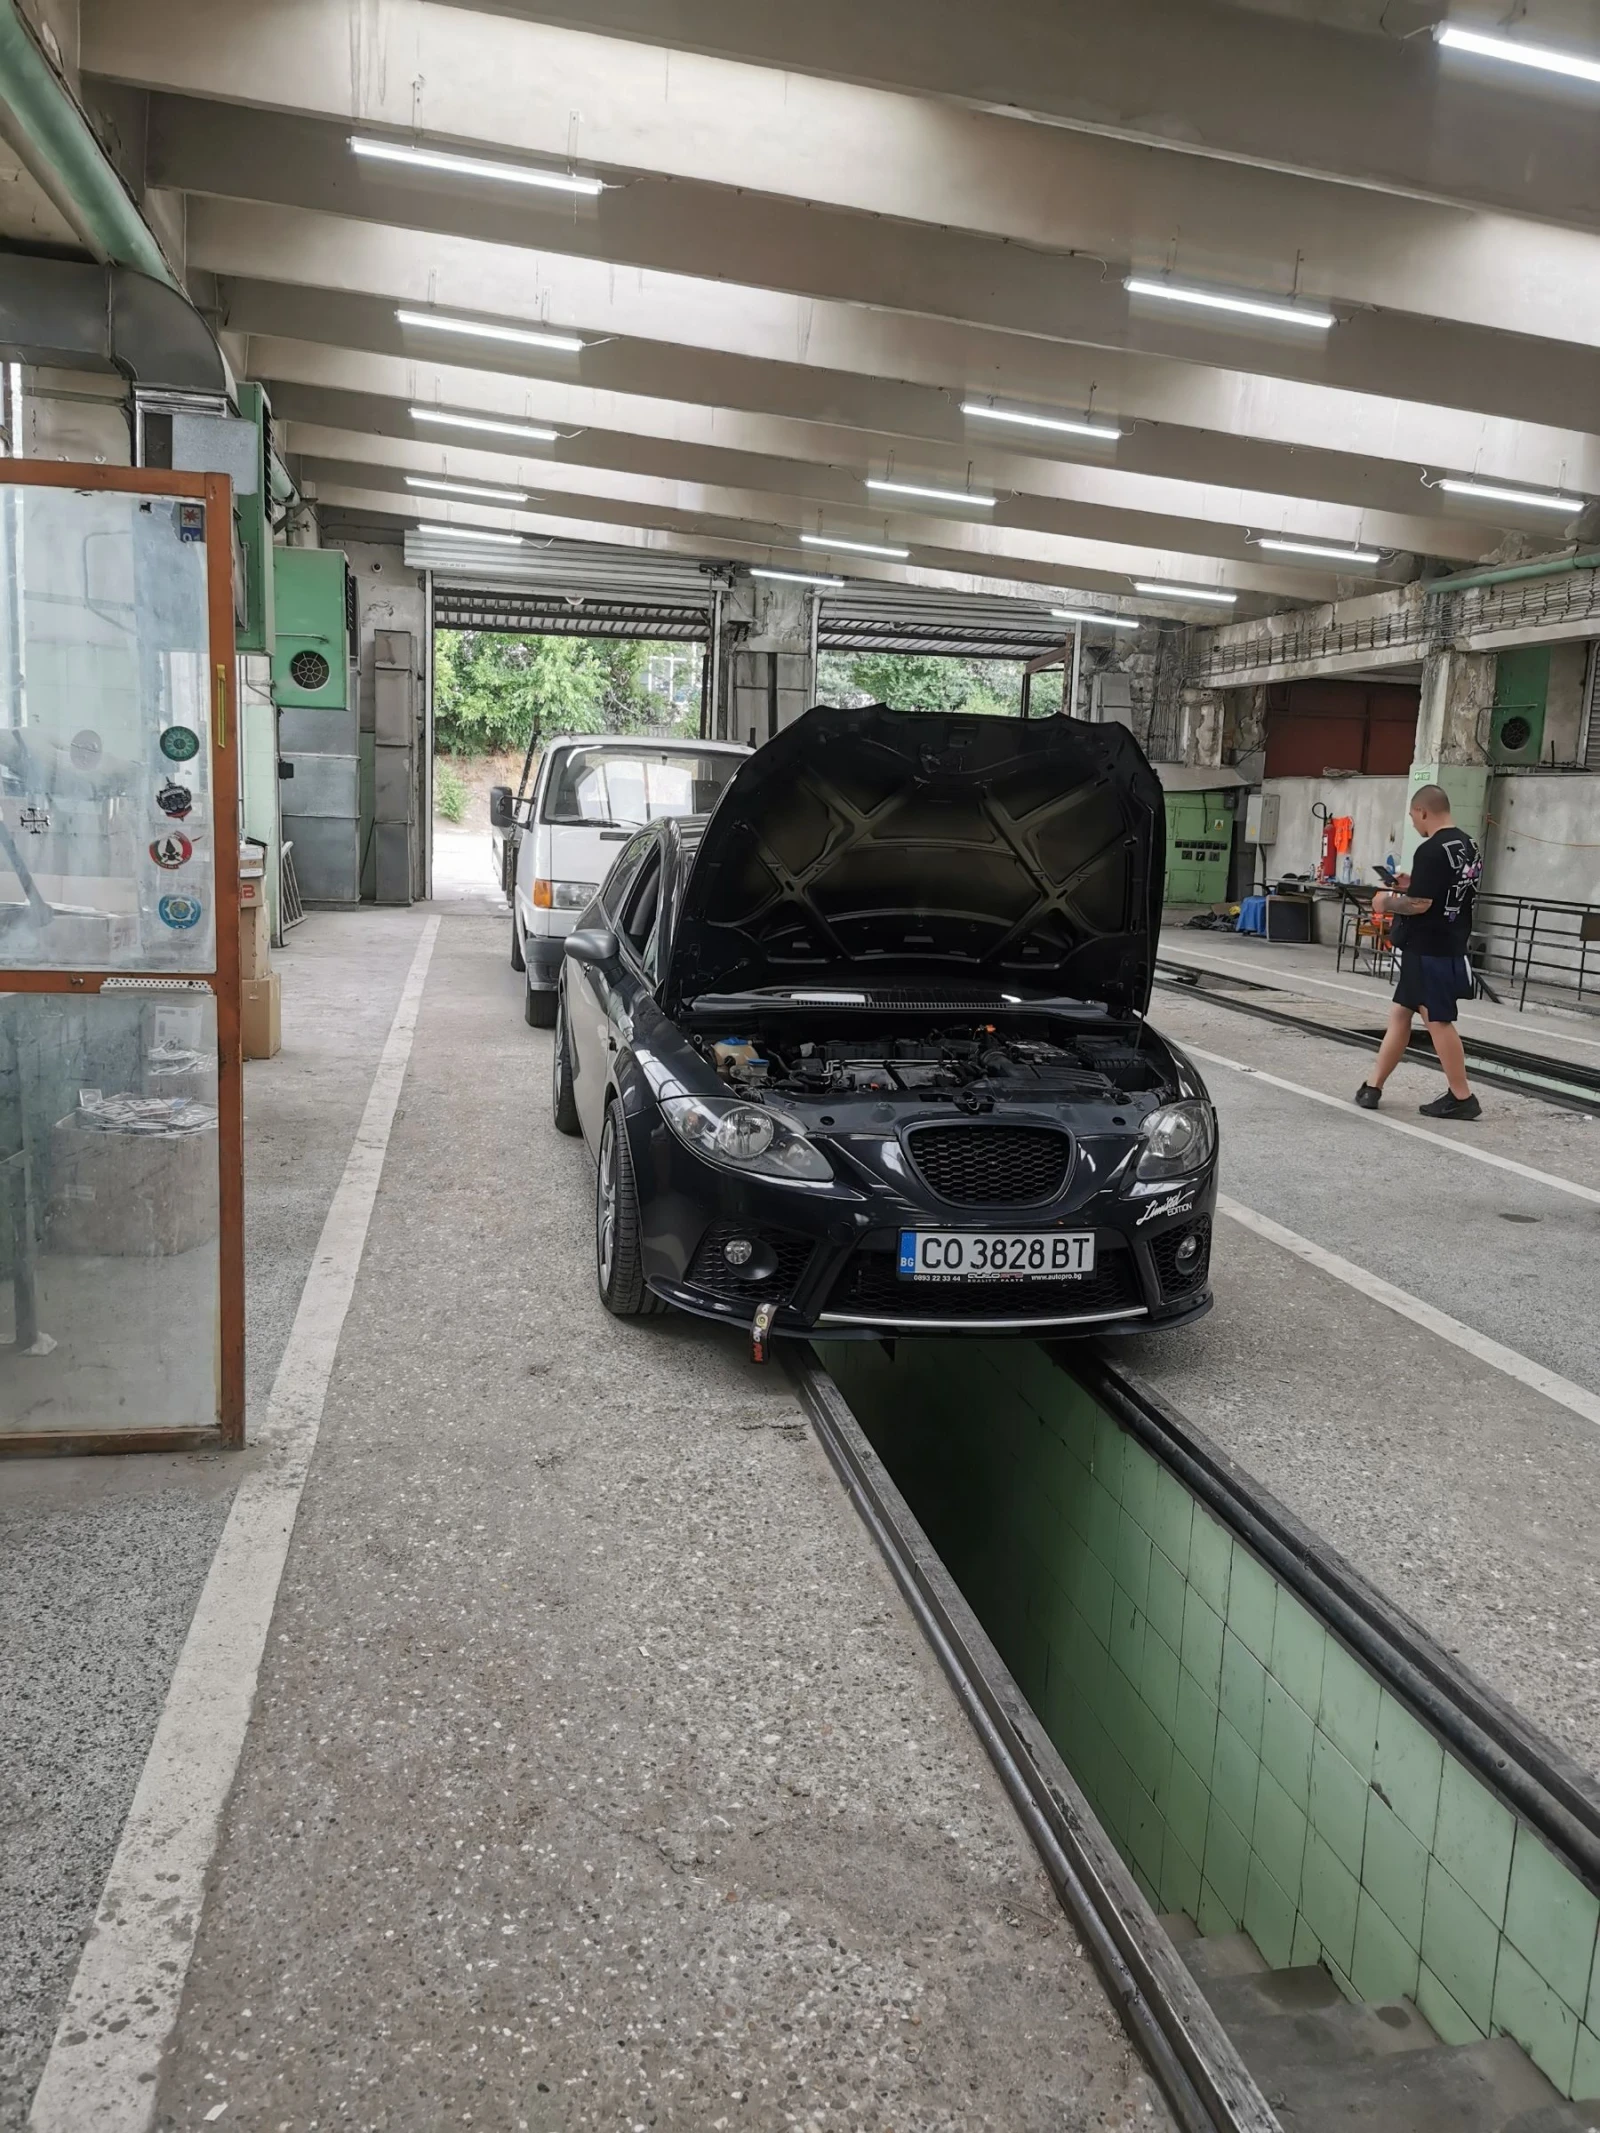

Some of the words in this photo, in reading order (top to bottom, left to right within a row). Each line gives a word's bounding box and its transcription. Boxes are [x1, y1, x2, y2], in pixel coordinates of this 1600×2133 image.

[1136, 1190, 1195, 1225] Limited
[1166, 1202, 1193, 1217] EDITION
[921, 1237, 963, 1269] CO
[970, 1238, 1045, 1270] 3828
[1051, 1237, 1090, 1269] BT
[900, 1257, 914, 1267] BG
[1031, 1273, 1082, 1281] www.autopro.bg
